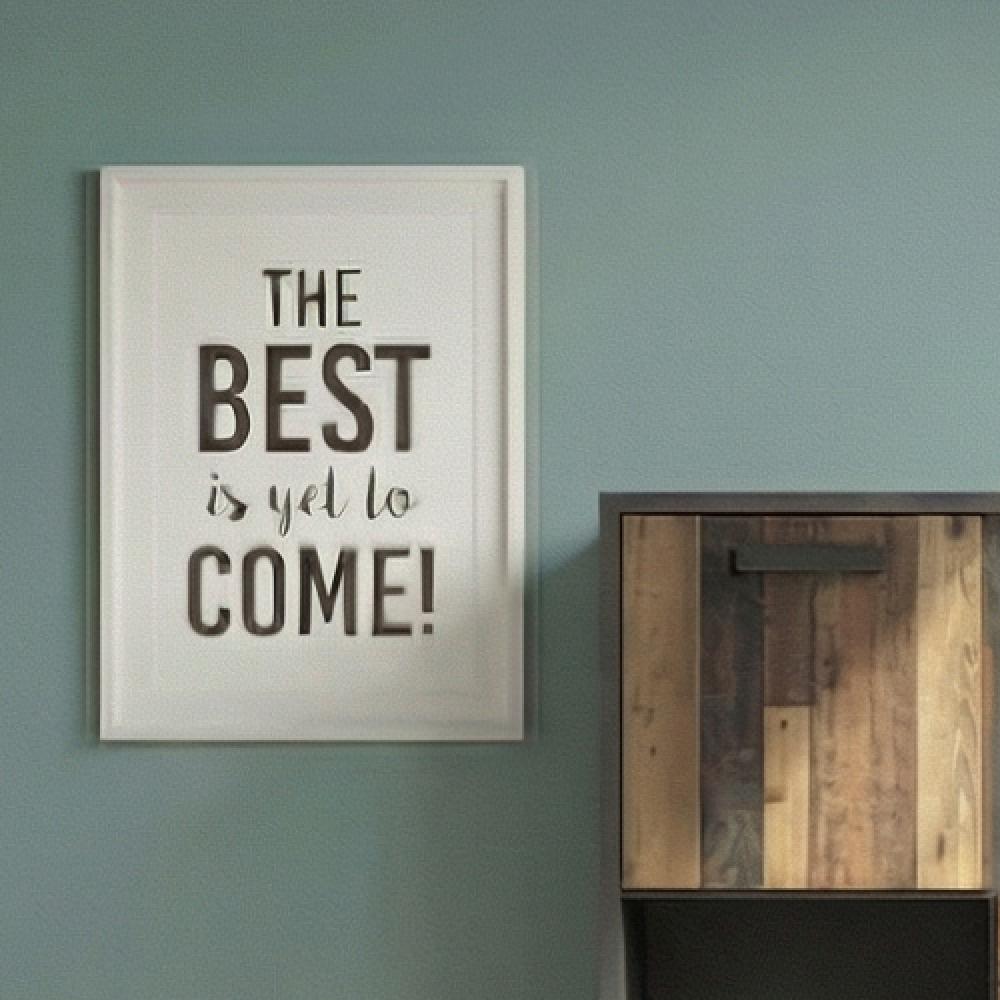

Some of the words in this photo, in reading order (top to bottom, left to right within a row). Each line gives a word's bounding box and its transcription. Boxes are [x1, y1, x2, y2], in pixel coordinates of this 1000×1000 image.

[261, 268, 363, 327] THE
[198, 343, 431, 453] BEST
[206, 472, 248, 521] is
[269, 466, 348, 537] yet
[366, 466, 414, 521] to
[187, 545, 435, 637] COME!
